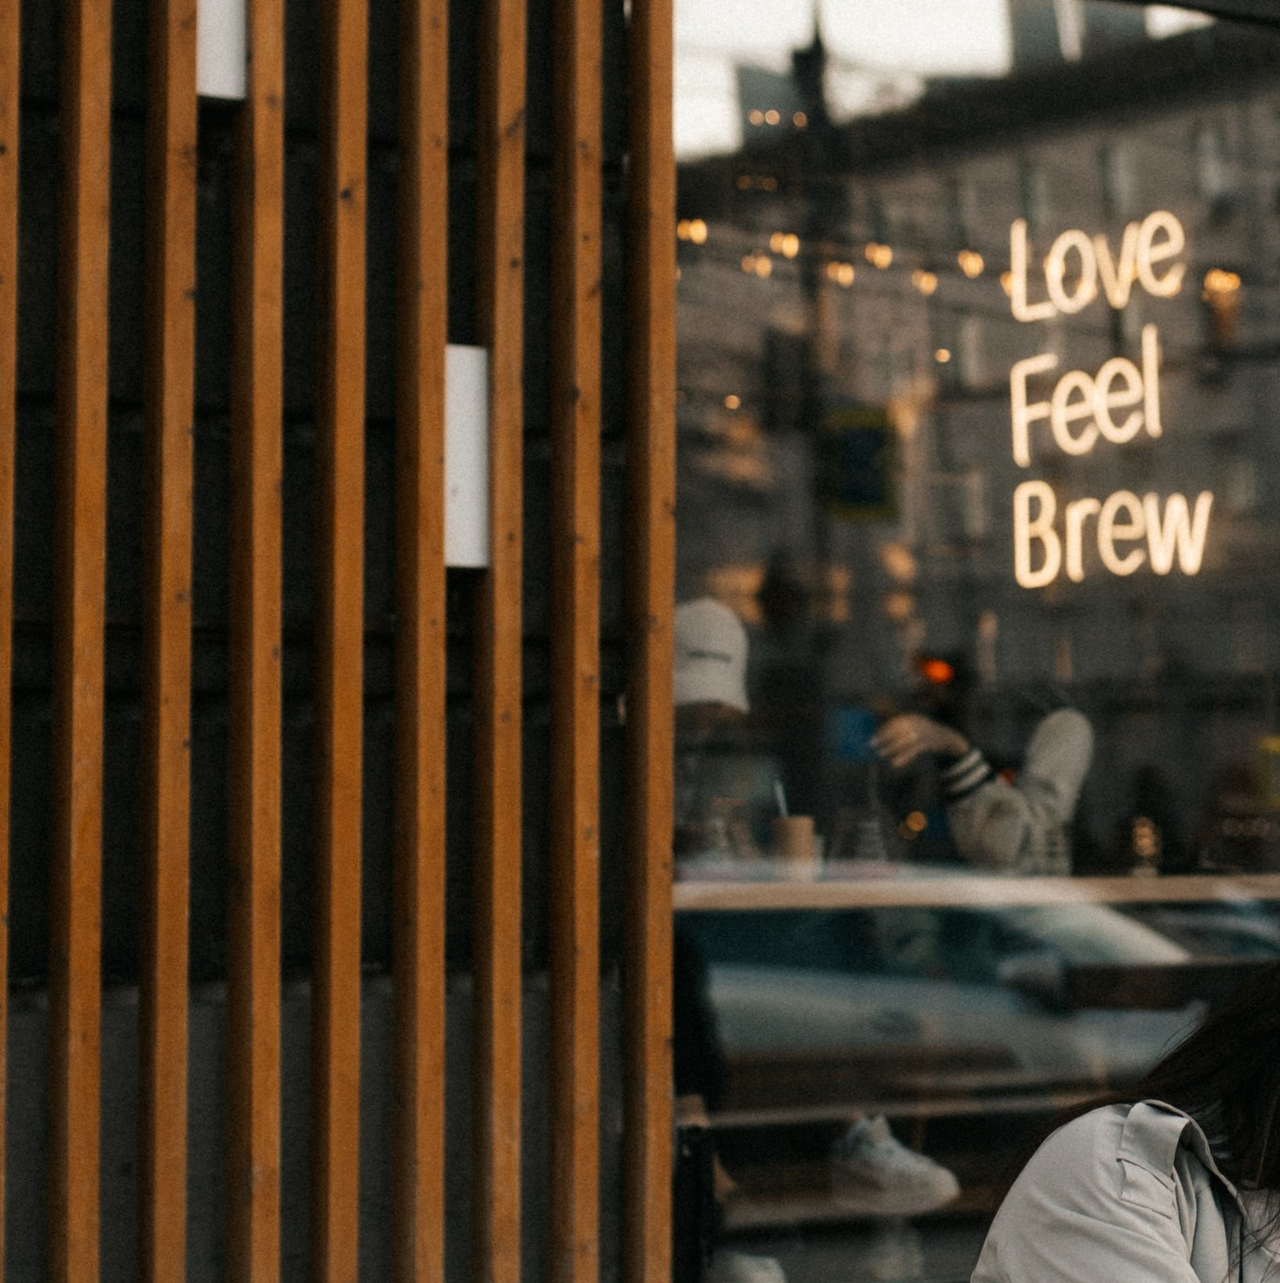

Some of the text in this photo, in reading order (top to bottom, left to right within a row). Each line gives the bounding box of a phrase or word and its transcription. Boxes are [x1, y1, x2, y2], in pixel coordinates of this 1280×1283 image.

[1009, 210, 1187, 323] Love
[1010, 323, 1162, 468] Feel
[1012, 480, 1215, 589] Brew
